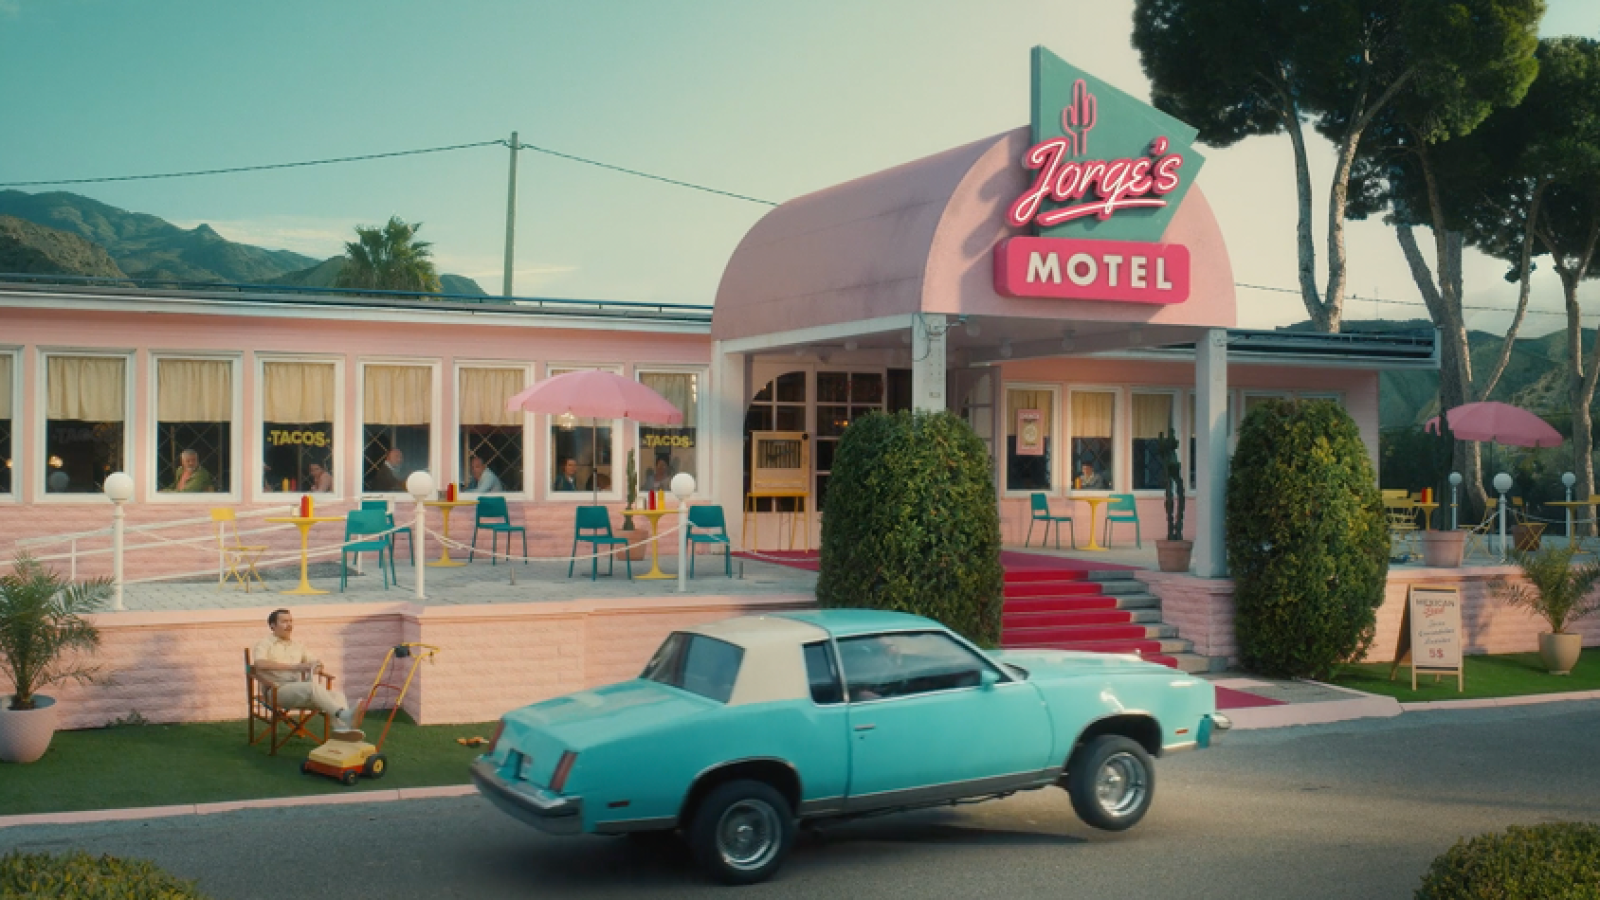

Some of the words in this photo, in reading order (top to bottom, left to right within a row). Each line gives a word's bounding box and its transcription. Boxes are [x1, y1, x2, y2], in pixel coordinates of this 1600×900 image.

[1009, 136, 1183, 225] Jorge's
[1026, 252, 1172, 290] MOTEL
[1416, 598, 1454, 607] MEXICAN
